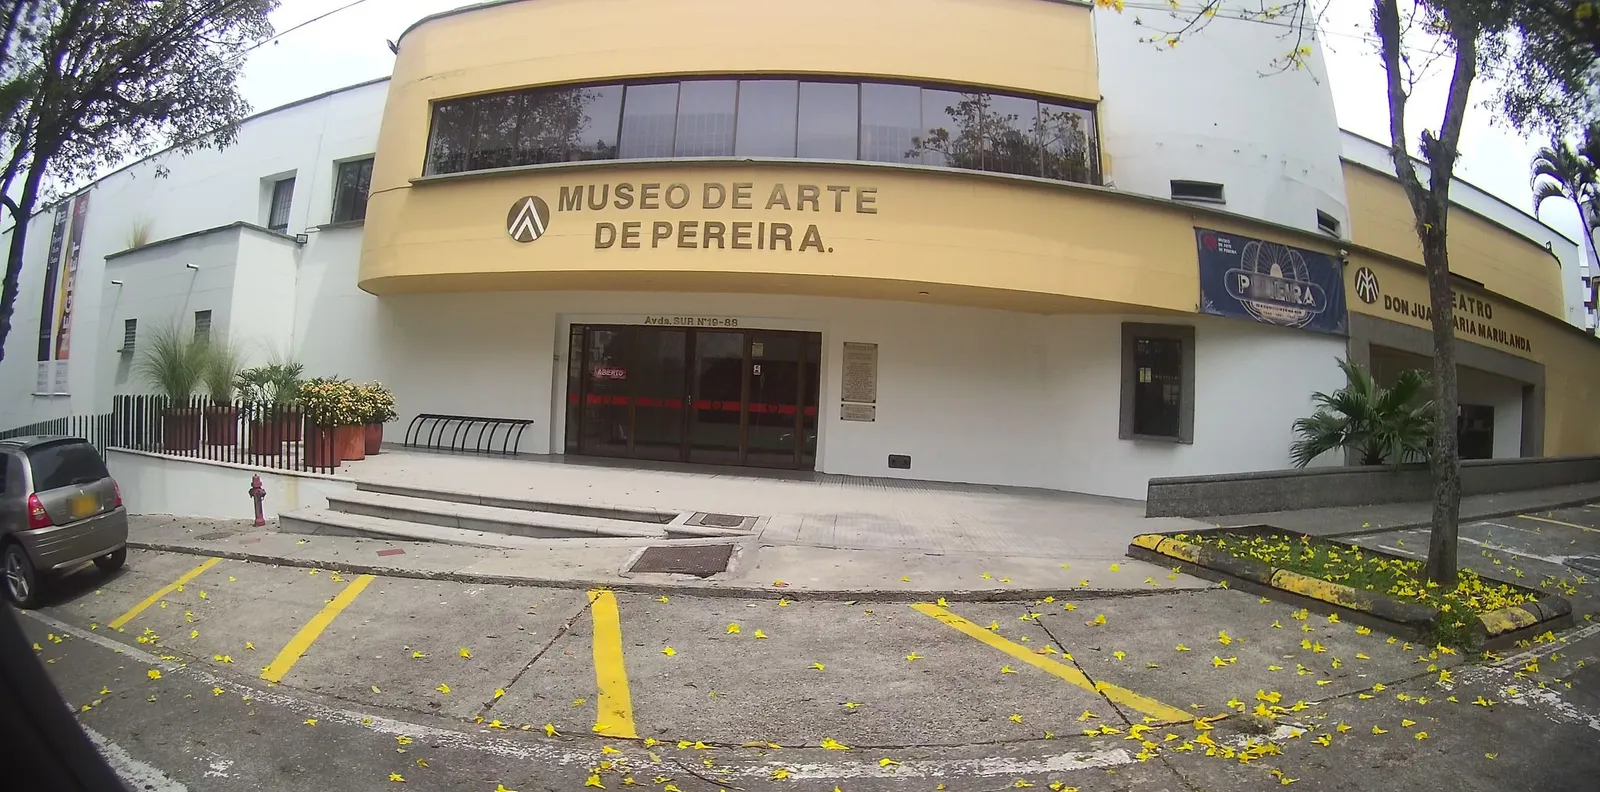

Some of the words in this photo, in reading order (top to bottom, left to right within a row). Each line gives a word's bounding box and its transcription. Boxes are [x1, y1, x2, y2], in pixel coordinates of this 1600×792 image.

[558, 182, 690, 211] MUSEO
[702, 182, 753, 210] DE
[765, 183, 878, 214] ARTE
[594, 221, 642, 249] DE
[651, 221, 834, 253] PEREIRA.
[673, 317, 694, 325] SUR
[1452, 291, 1493, 320] EATRO
[1384, 294, 1409, 315] DON
[1411, 303, 1432, 321] JUA
[1453, 315, 1476, 335] ARIA
[1478, 323, 1531, 353] MARULANDA
